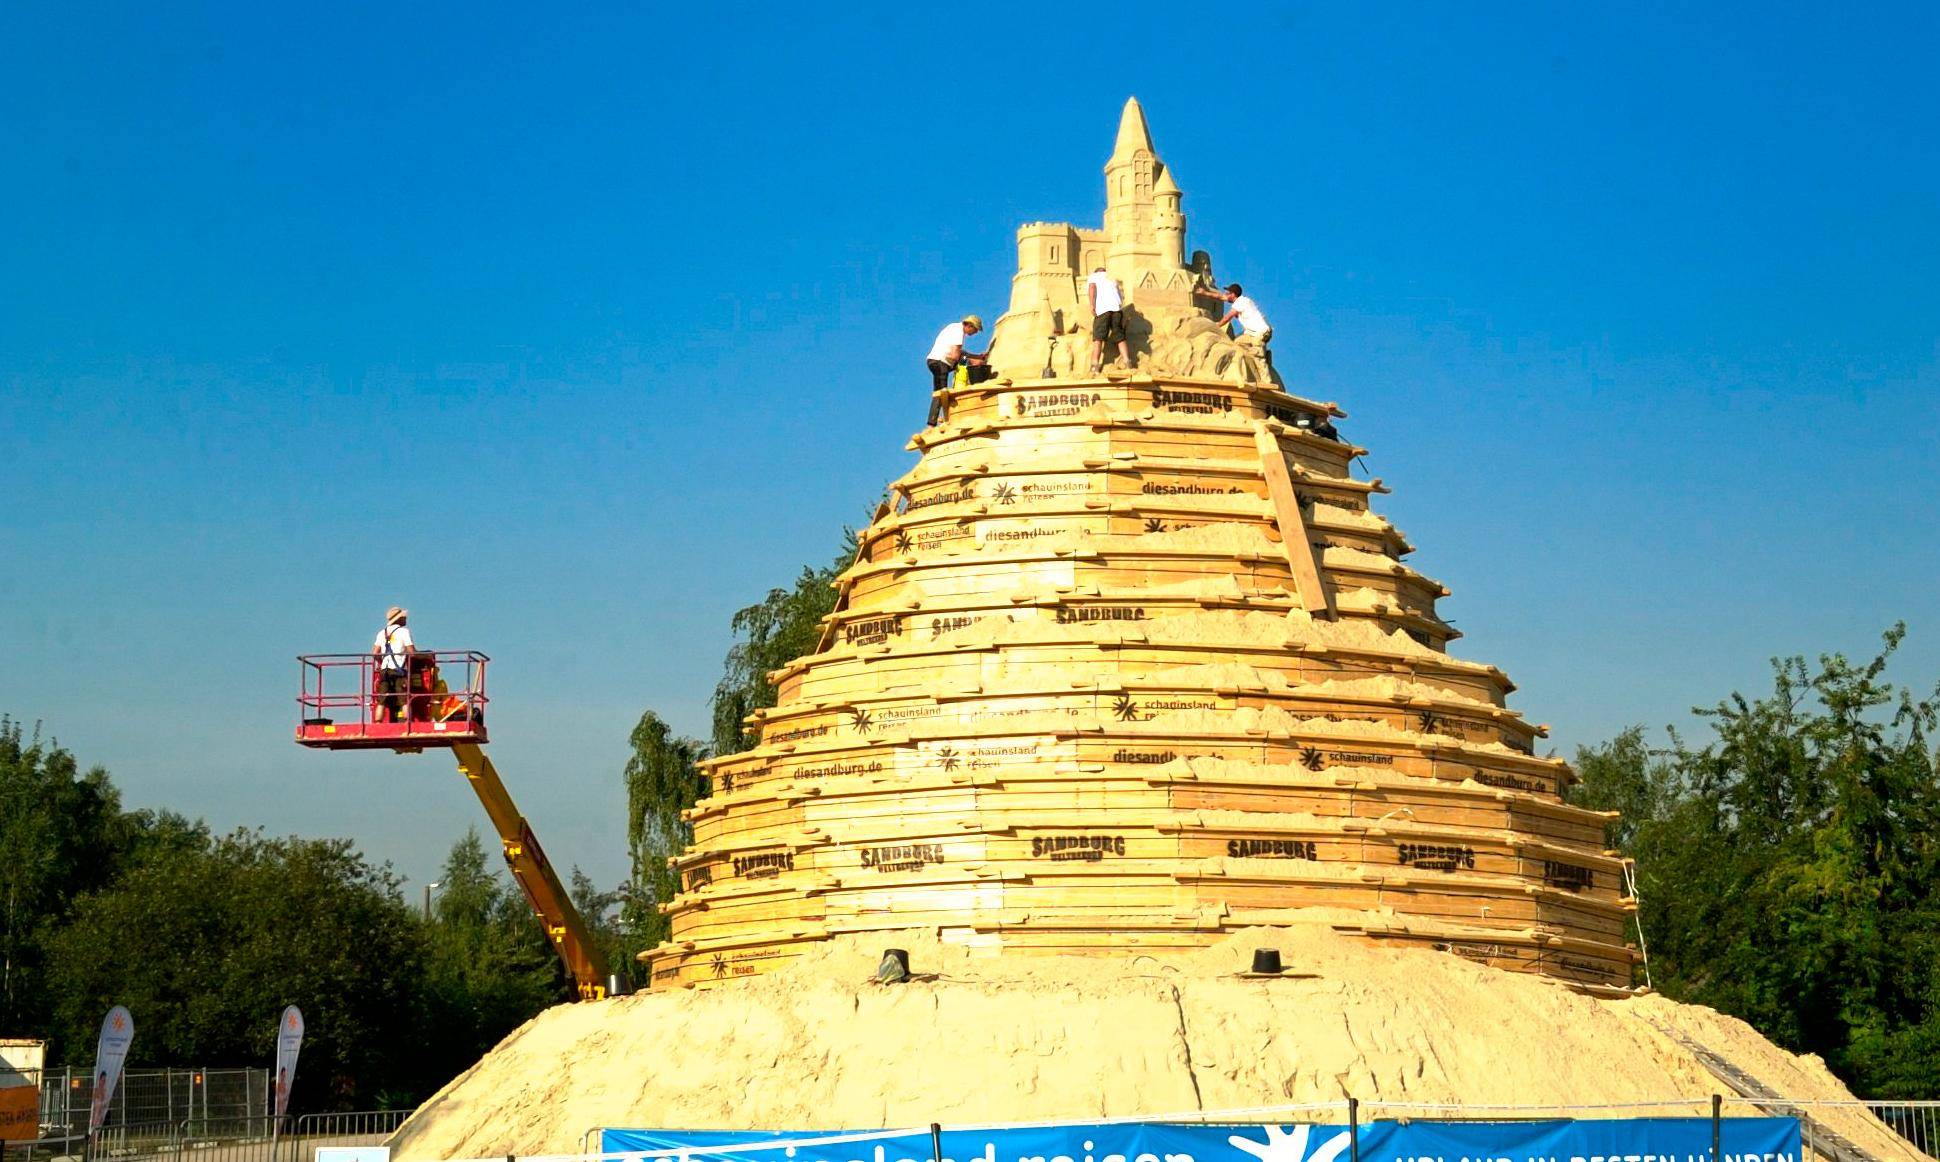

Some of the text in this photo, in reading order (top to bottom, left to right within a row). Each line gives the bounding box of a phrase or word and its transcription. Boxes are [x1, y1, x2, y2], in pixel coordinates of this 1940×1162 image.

[846, 615, 903, 644] SANDBURG
[878, 706, 941, 719] schauinsland
[1329, 752, 1394, 765] schauinsland
[793, 761, 883, 780] diesandburg.de
[861, 844, 944, 869] SANDBURG
[1032, 836, 1126, 857] SANDBURG
[1227, 840, 1317, 861] SANDBURG
[1399, 844, 1475, 869] SANDBURG
[734, 852, 795, 877] SANDBURG
